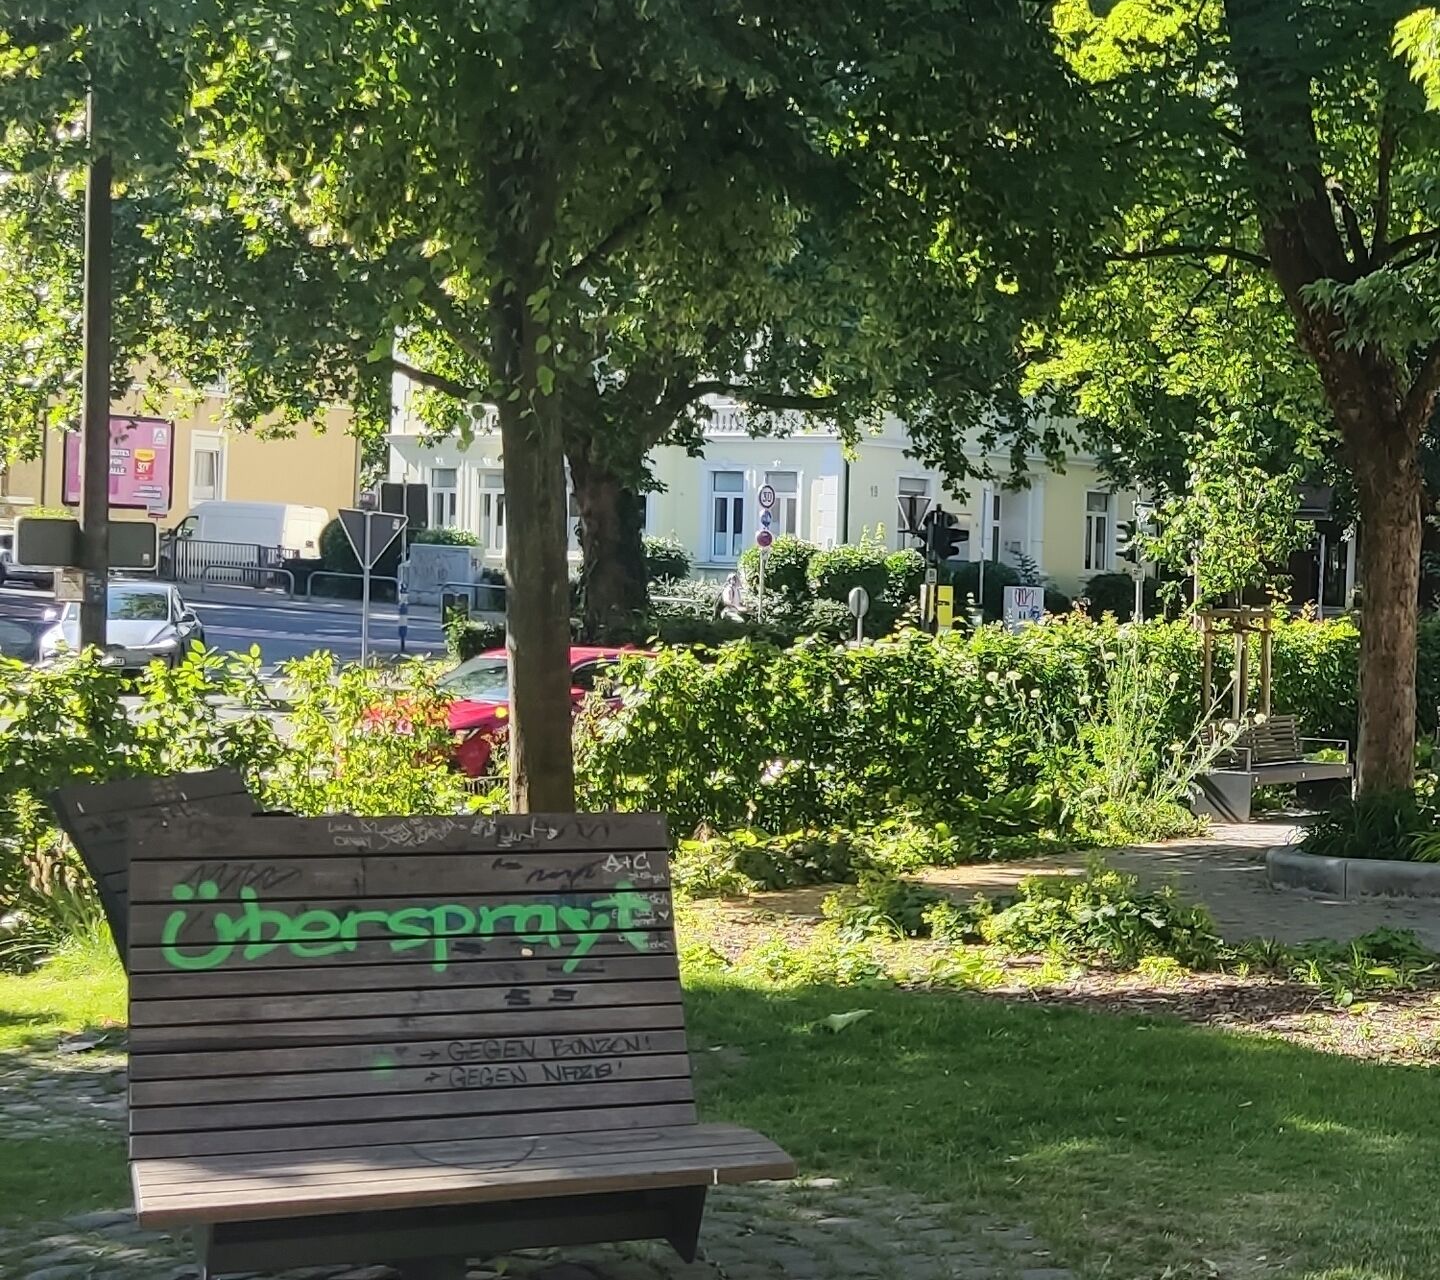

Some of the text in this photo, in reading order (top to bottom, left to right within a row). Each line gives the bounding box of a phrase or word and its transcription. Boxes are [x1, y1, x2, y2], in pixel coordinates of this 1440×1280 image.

[762, 491, 772, 503] 30
[447, 1039, 535, 1061] GEGEN
[450, 1066, 528, 1087] GEGEN
